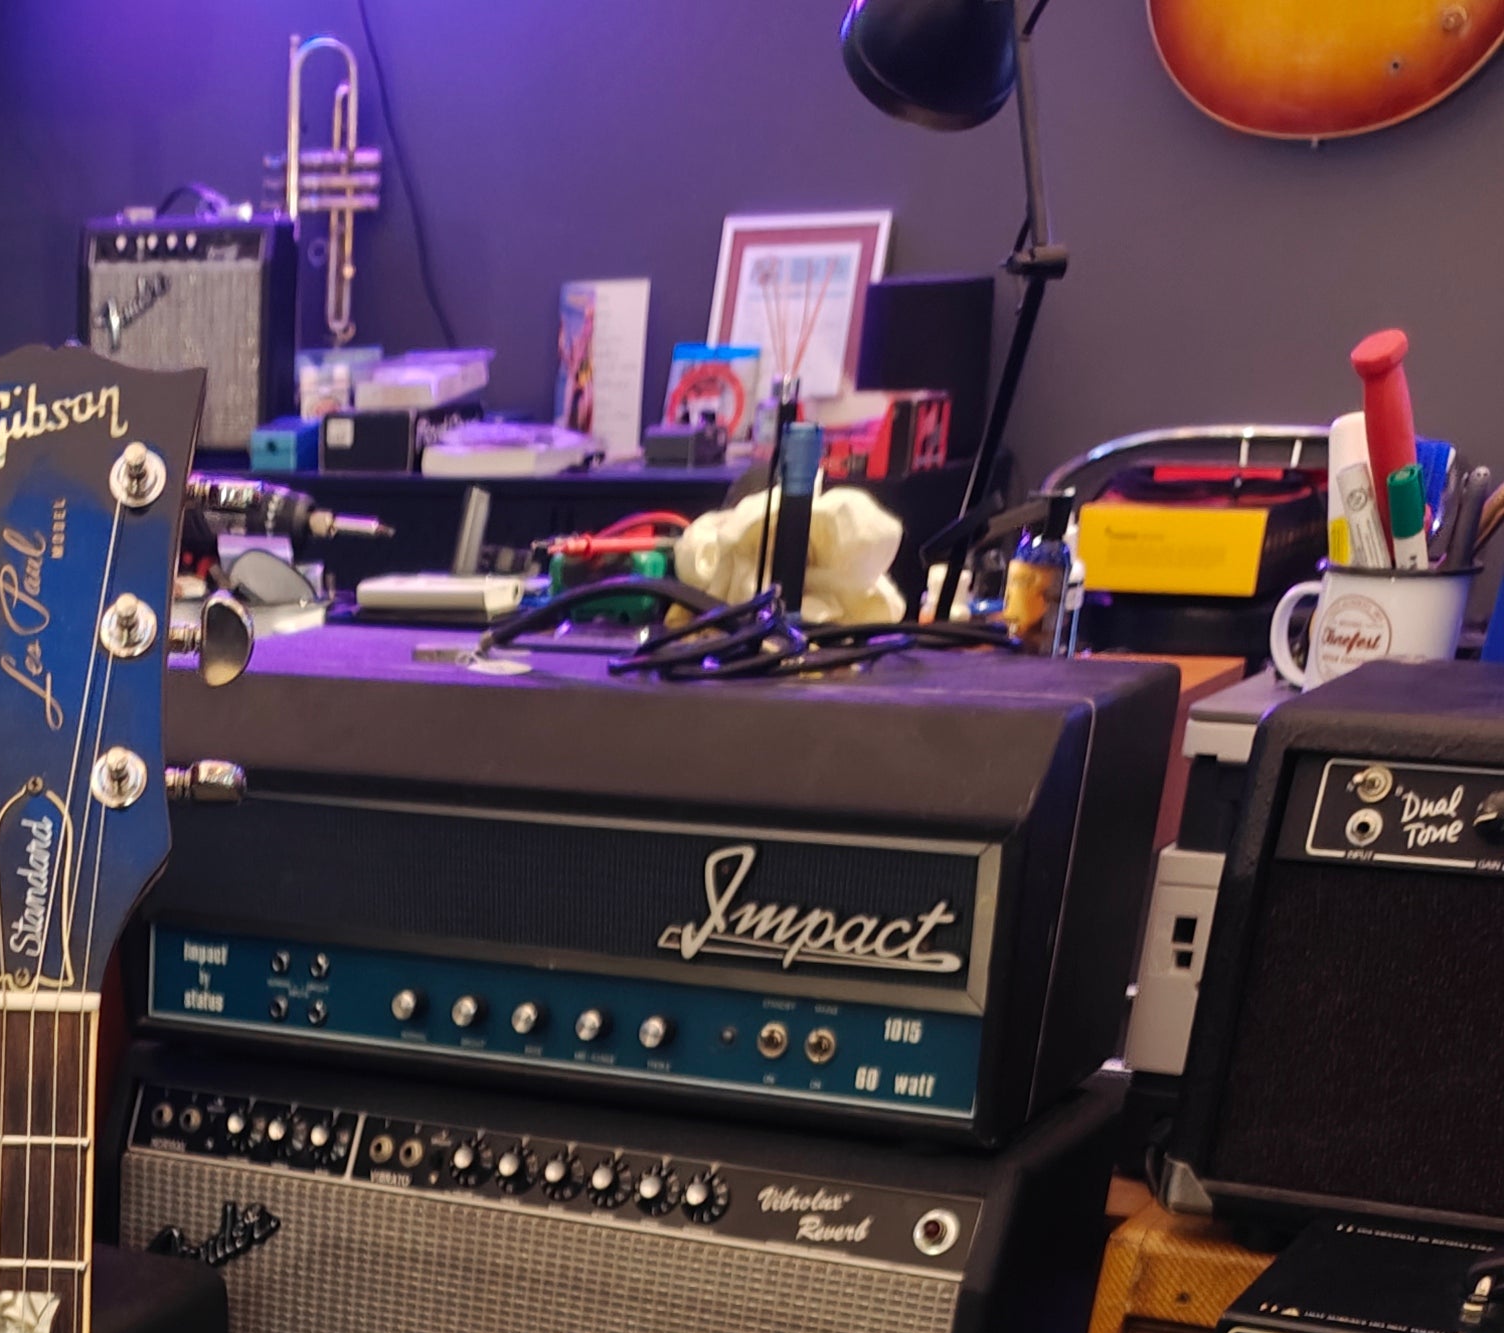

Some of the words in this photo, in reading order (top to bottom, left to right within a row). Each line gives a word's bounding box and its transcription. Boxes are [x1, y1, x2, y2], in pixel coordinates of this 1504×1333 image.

[51, 498, 66, 559] MODEL
[0, 639, 63, 731] Les
[1400, 784, 1464, 823] Dual
[1404, 819, 1464, 849] Tone
[9, 815, 53, 958] Standard
[657, 845, 962, 973] Impact
[183, 988, 225, 1013] status
[884, 1017, 922, 1044] 1015
[854, 1065, 880, 1092] 60
[894, 1072, 935, 1098] watt
[369, 1169, 412, 1187] VIBRATO
[757, 1184, 850, 1212] Vibrolux
[796, 1214, 874, 1242] Reverb
